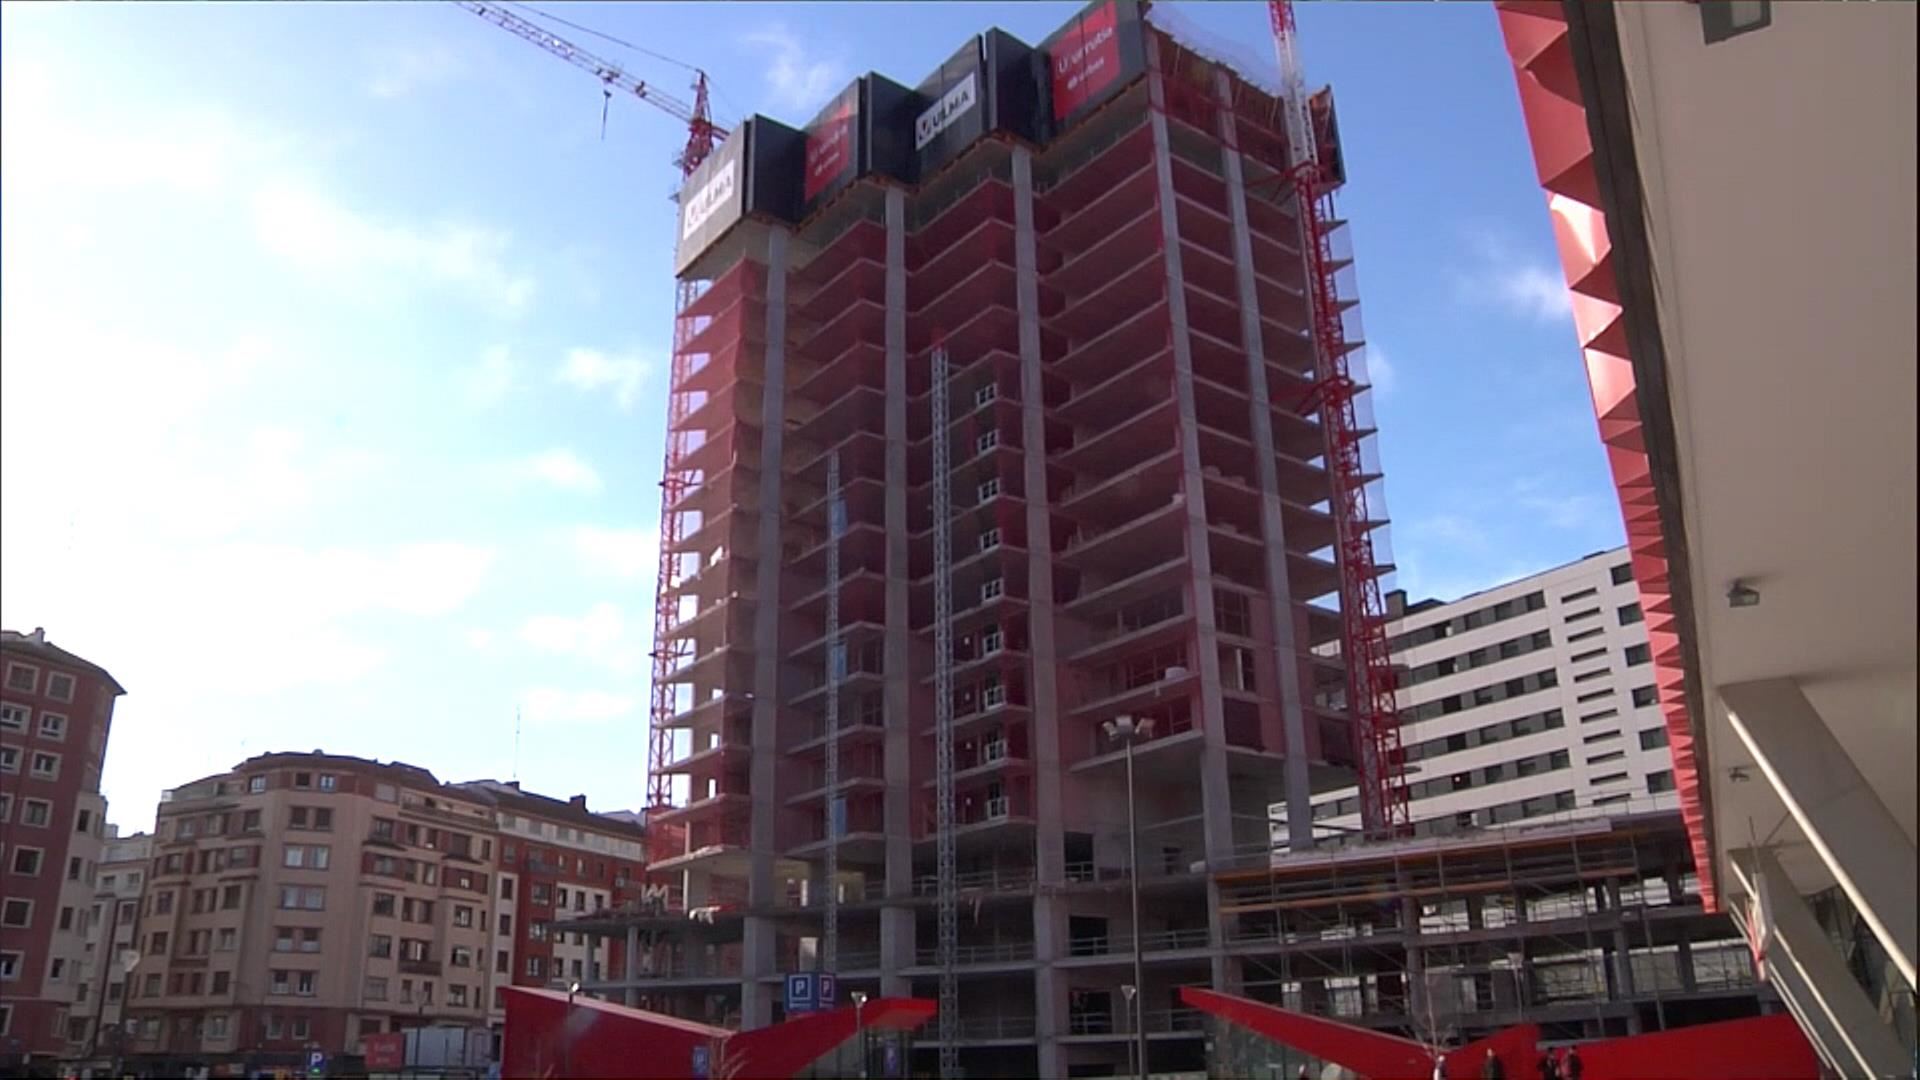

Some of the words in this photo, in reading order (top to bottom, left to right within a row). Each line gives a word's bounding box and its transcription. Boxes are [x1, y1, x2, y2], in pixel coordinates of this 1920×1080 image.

[933, 91, 969, 127] ULMA
[795, 980, 805, 995] P
[823, 980, 830, 995] P
[311, 1052, 323, 1066] P
